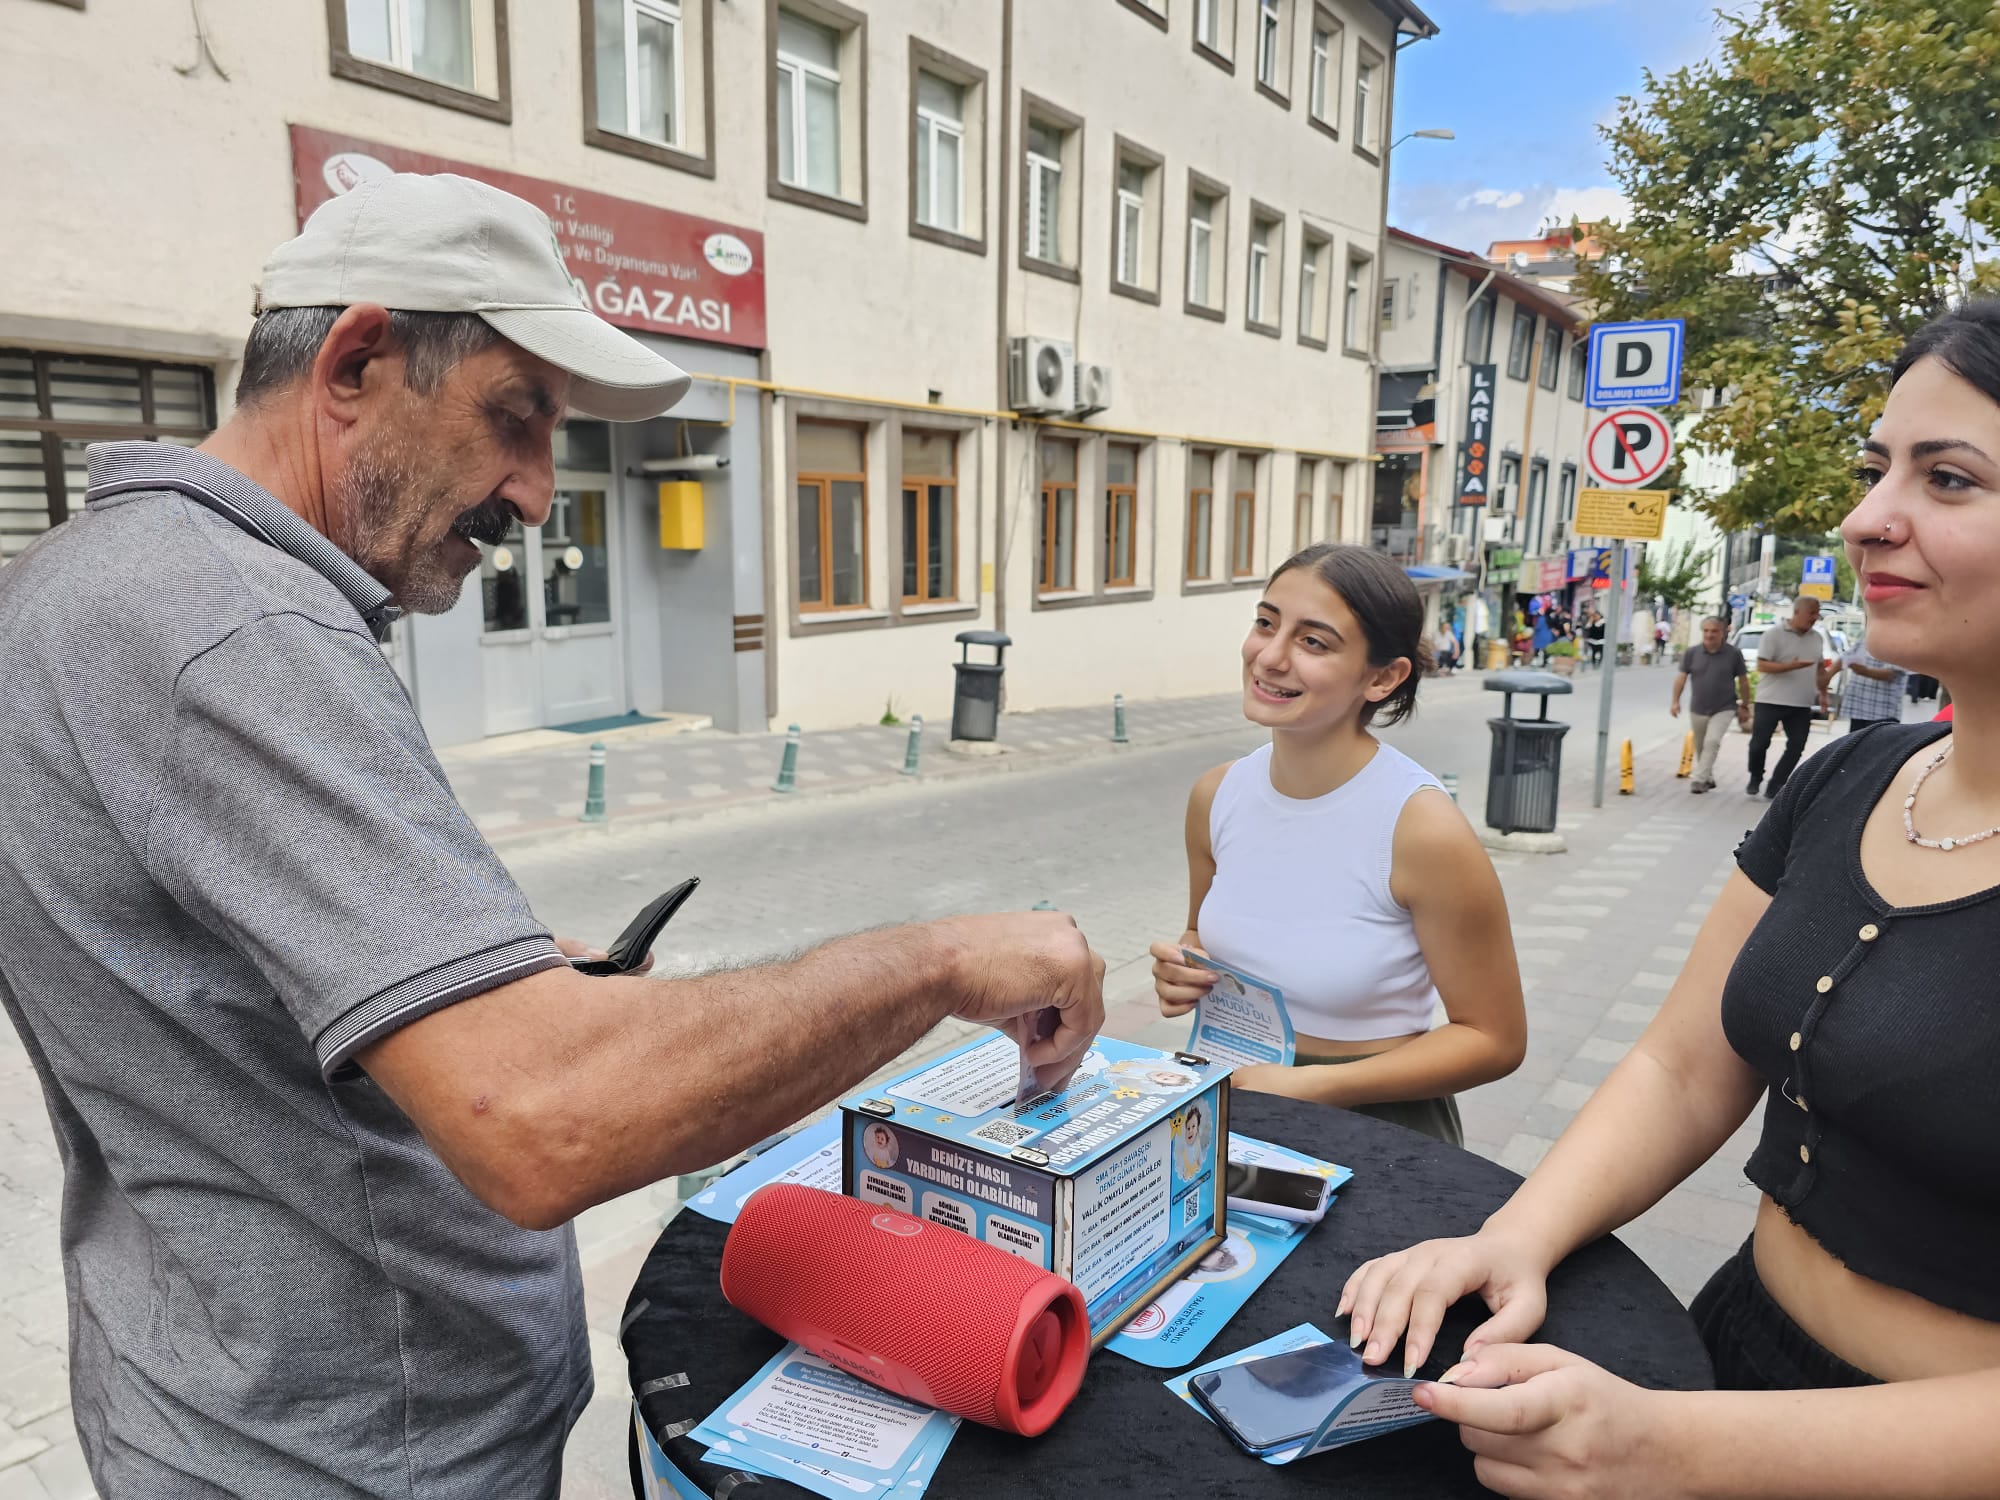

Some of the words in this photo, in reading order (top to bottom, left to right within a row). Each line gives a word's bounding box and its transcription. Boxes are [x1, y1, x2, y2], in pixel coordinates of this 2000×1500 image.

[574, 243, 592, 262] Ve
[572, 274, 731, 334] AĞAZASI
[1615, 341, 1652, 378] D
[1612, 423, 1652, 470] P
[1811, 559, 1826, 574] P
[1089, 1101, 1122, 1124] DENİZ
[931, 1147, 974, 1176] DENİZ'E
[975, 1161, 1011, 1188] NASIL
[1096, 1171, 1108, 1184] SMA
[906, 1158, 964, 1191] YARDIMCI
[966, 1179, 1038, 1217] OLABİLİRİM
[1104, 1185, 1124, 1206] ONAYLI
